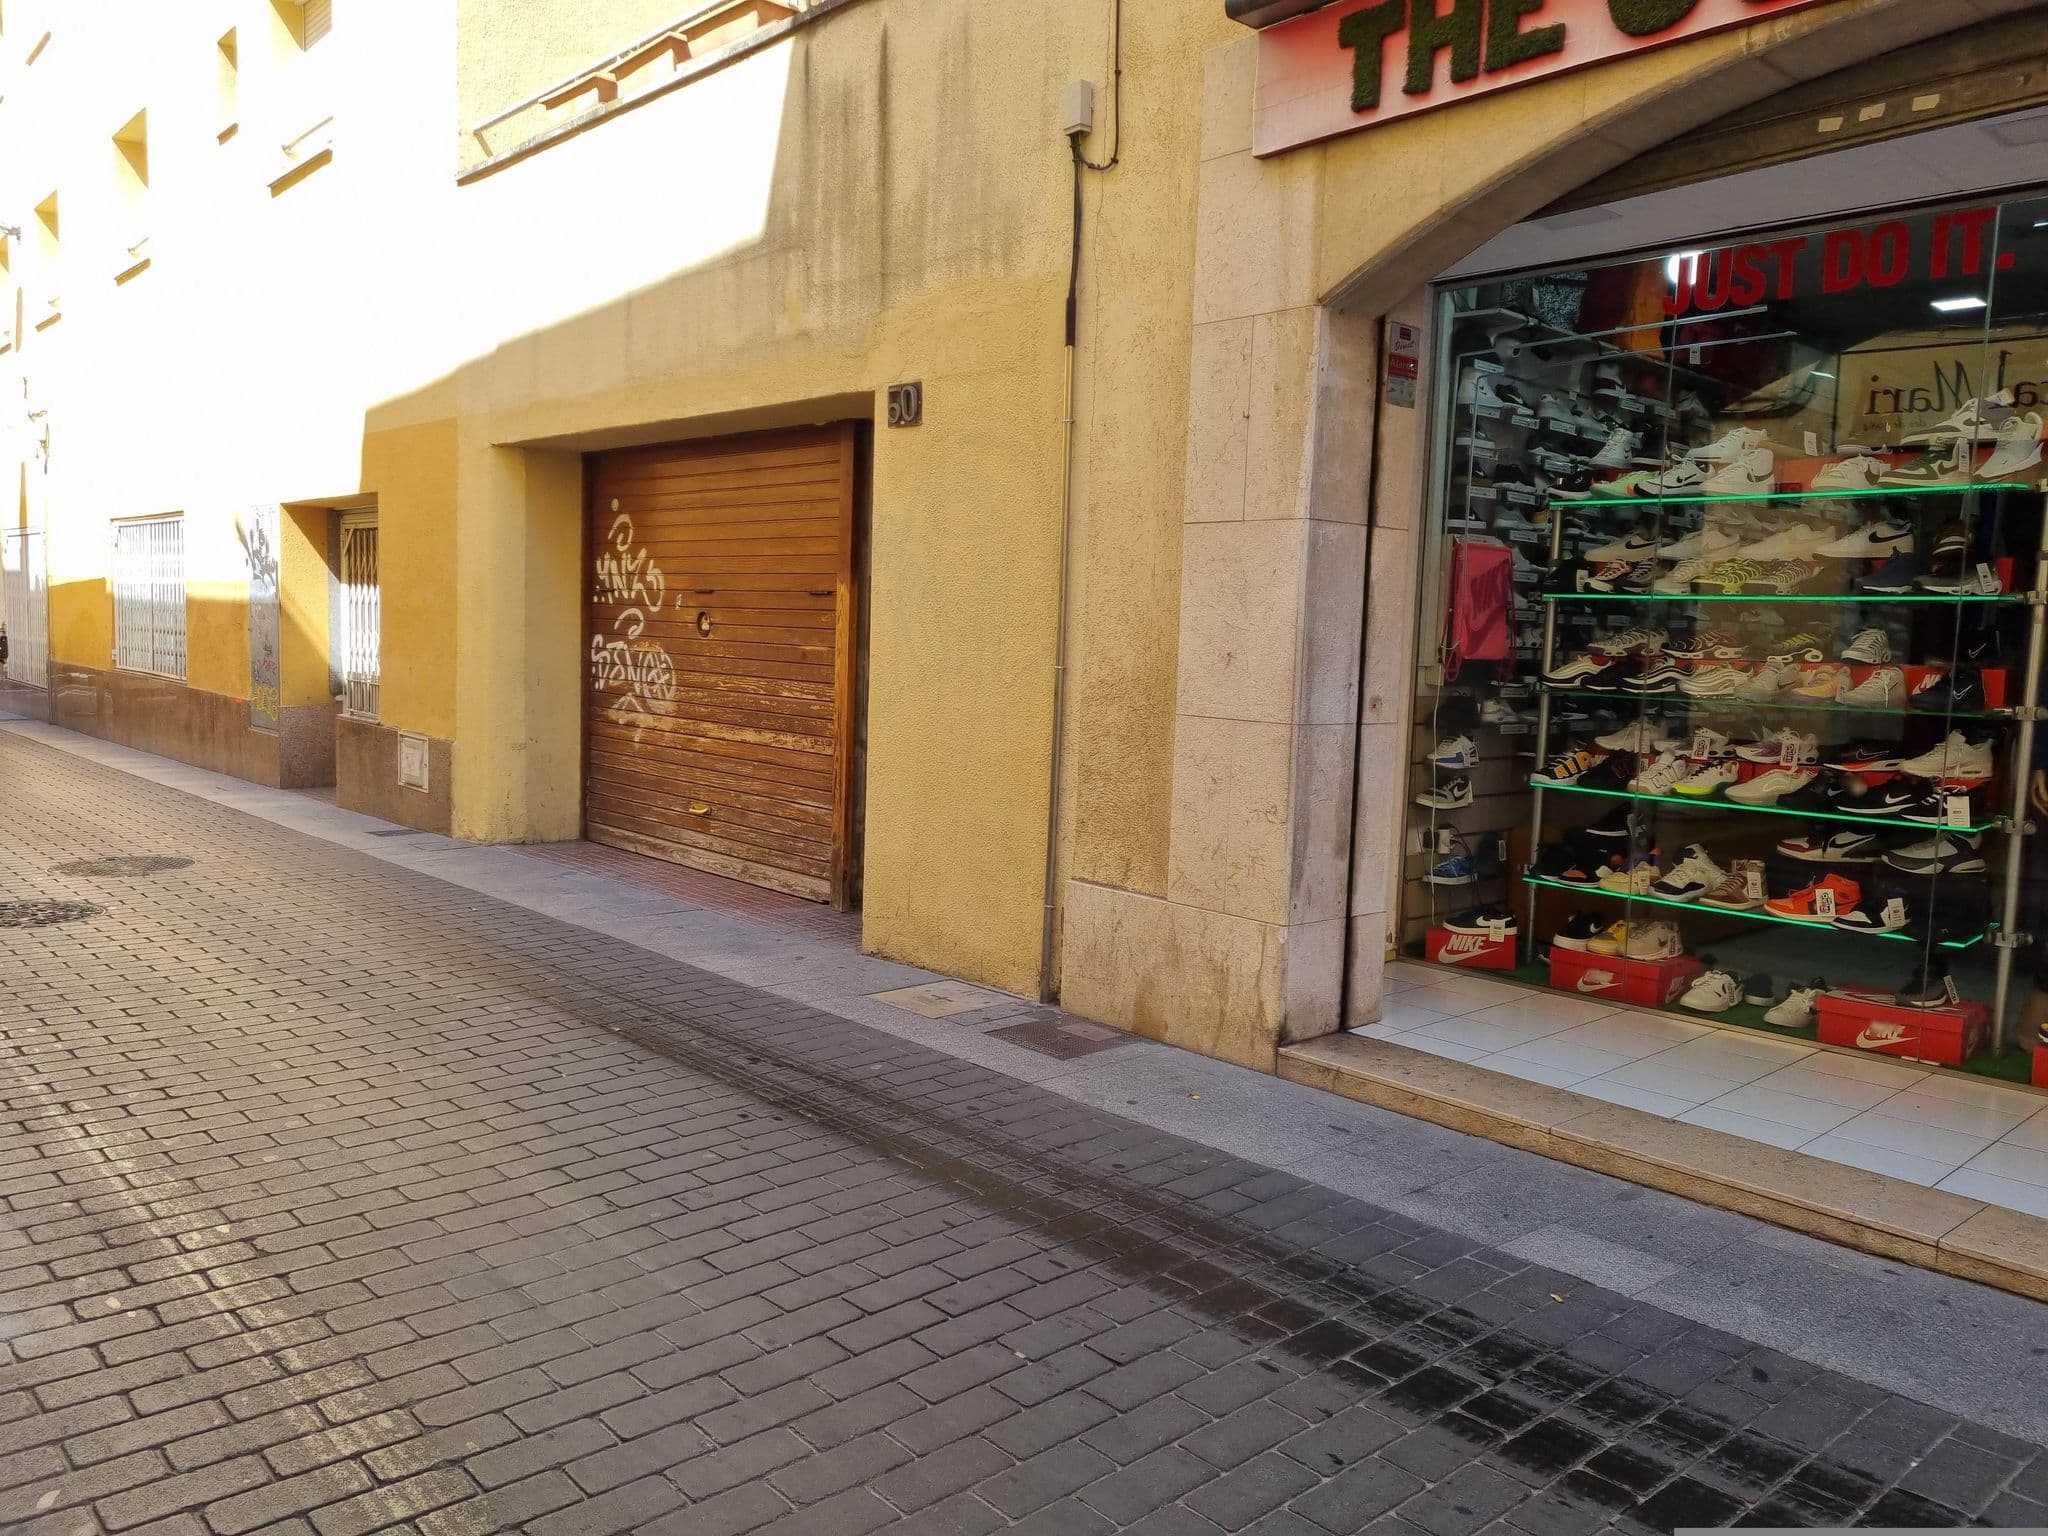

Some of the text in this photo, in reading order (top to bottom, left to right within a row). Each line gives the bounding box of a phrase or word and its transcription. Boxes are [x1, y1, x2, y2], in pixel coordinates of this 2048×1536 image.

[1339, 0, 1566, 113] THE
[1663, 237, 1808, 315] JUST
[1822, 219, 1911, 294] DO
[1446, 934, 1487, 952] NIKE
